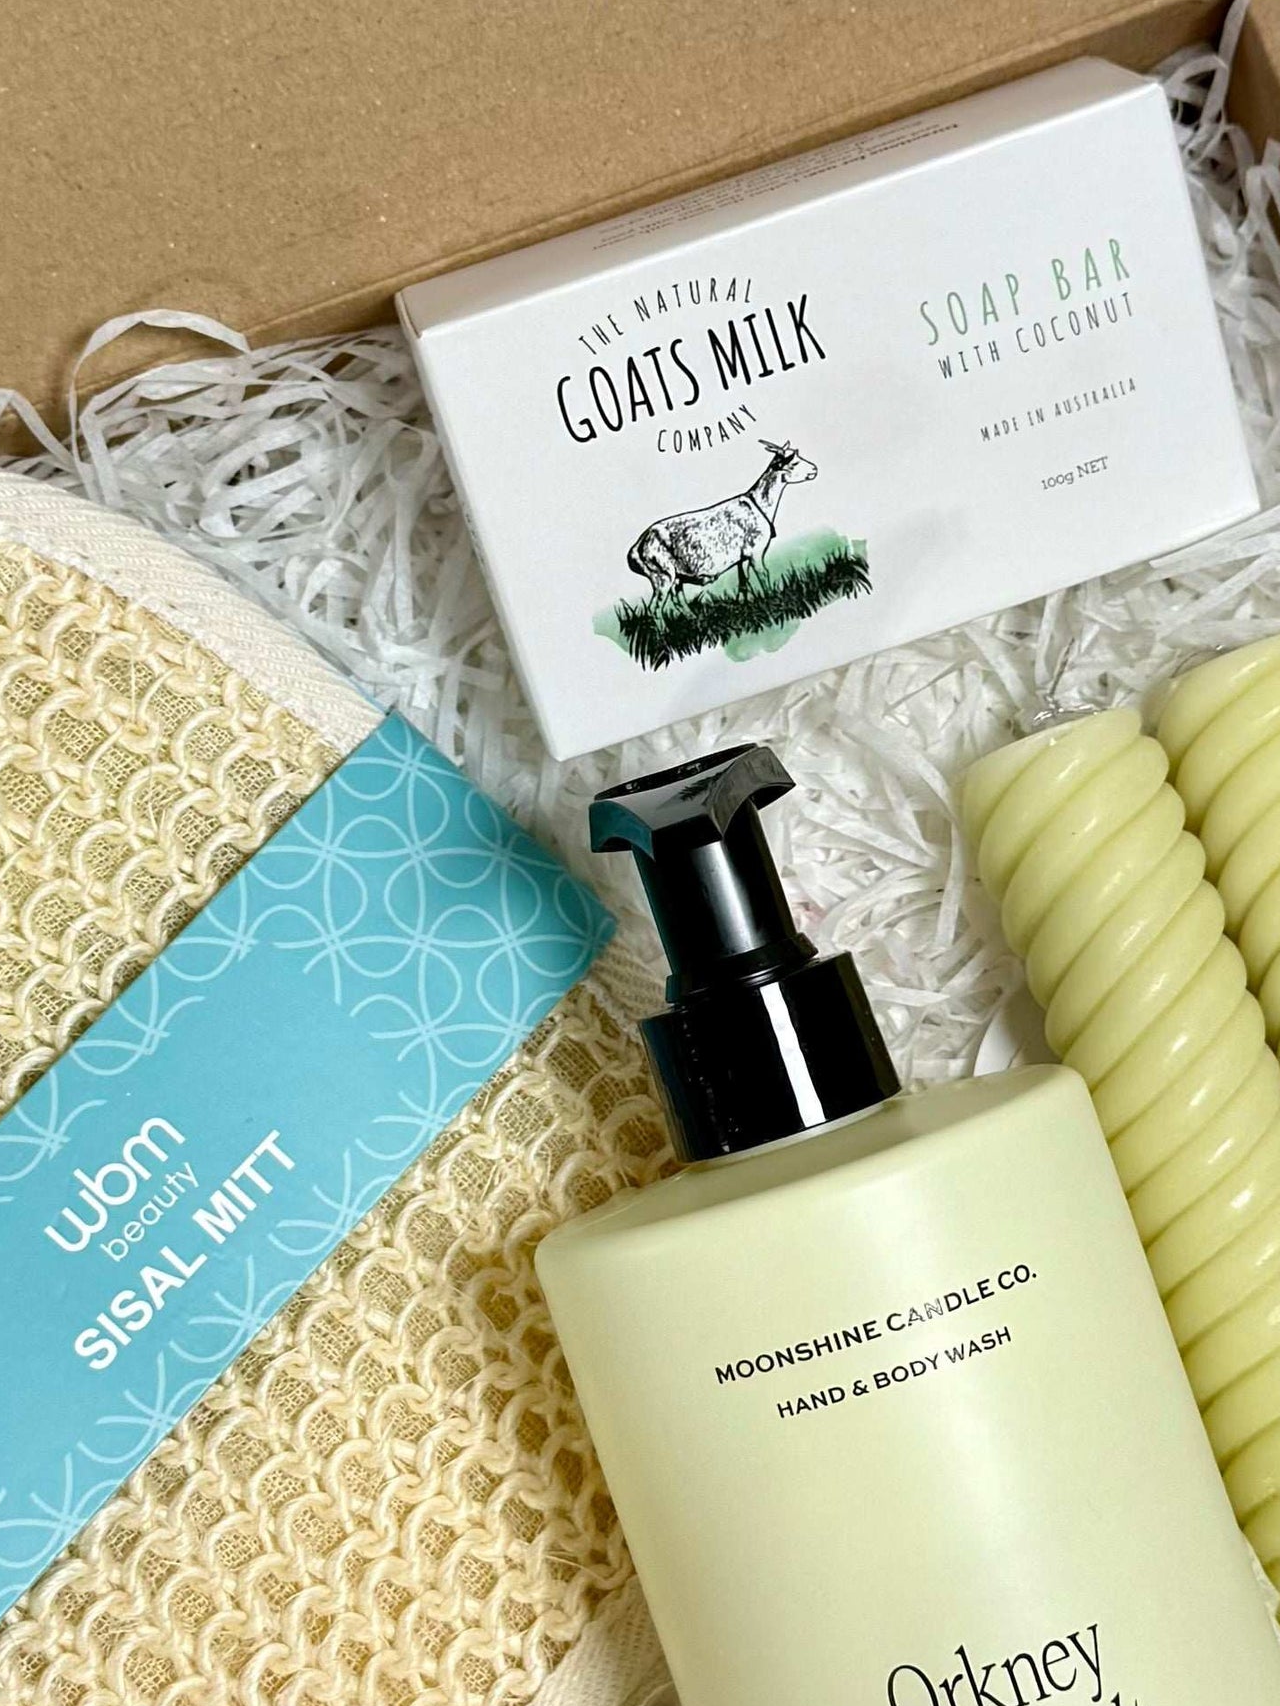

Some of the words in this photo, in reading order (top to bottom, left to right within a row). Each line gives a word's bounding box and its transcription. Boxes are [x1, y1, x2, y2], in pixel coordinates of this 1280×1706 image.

[578, 314, 624, 355] THE
[633, 277, 751, 323] NATURAL
[920, 273, 1020, 346] SOAP
[1051, 238, 1130, 301] BAR
[938, 340, 1001, 379] WITH
[1015, 292, 1133, 353] COCONUT
[557, 338, 700, 443] GOATS
[707, 294, 826, 390] MILK
[980, 417, 1019, 442] MADE
[1027, 407, 1046, 427] IN
[1054, 377, 1137, 417] AUSTRALIA
[657, 404, 756, 453] COMPANY
[1041, 471, 1075, 491] 100g
[1076, 455, 1109, 478] NET
[43, 1117, 186, 1253] wbm
[100, 1161, 200, 1263] beauty
[74, 1246, 208, 1371] SISAL
[191, 1129, 297, 1245] MITT
[715, 1320, 882, 1385] MOONSHINE
[886, 1279, 995, 1331] CANDLE
[997, 1264, 1037, 1291] CO.
[777, 1386, 846, 1419] HAND
[852, 1380, 870, 1397] &
[872, 1353, 940, 1390] BODY
[944, 1326, 1012, 1364] WASH
